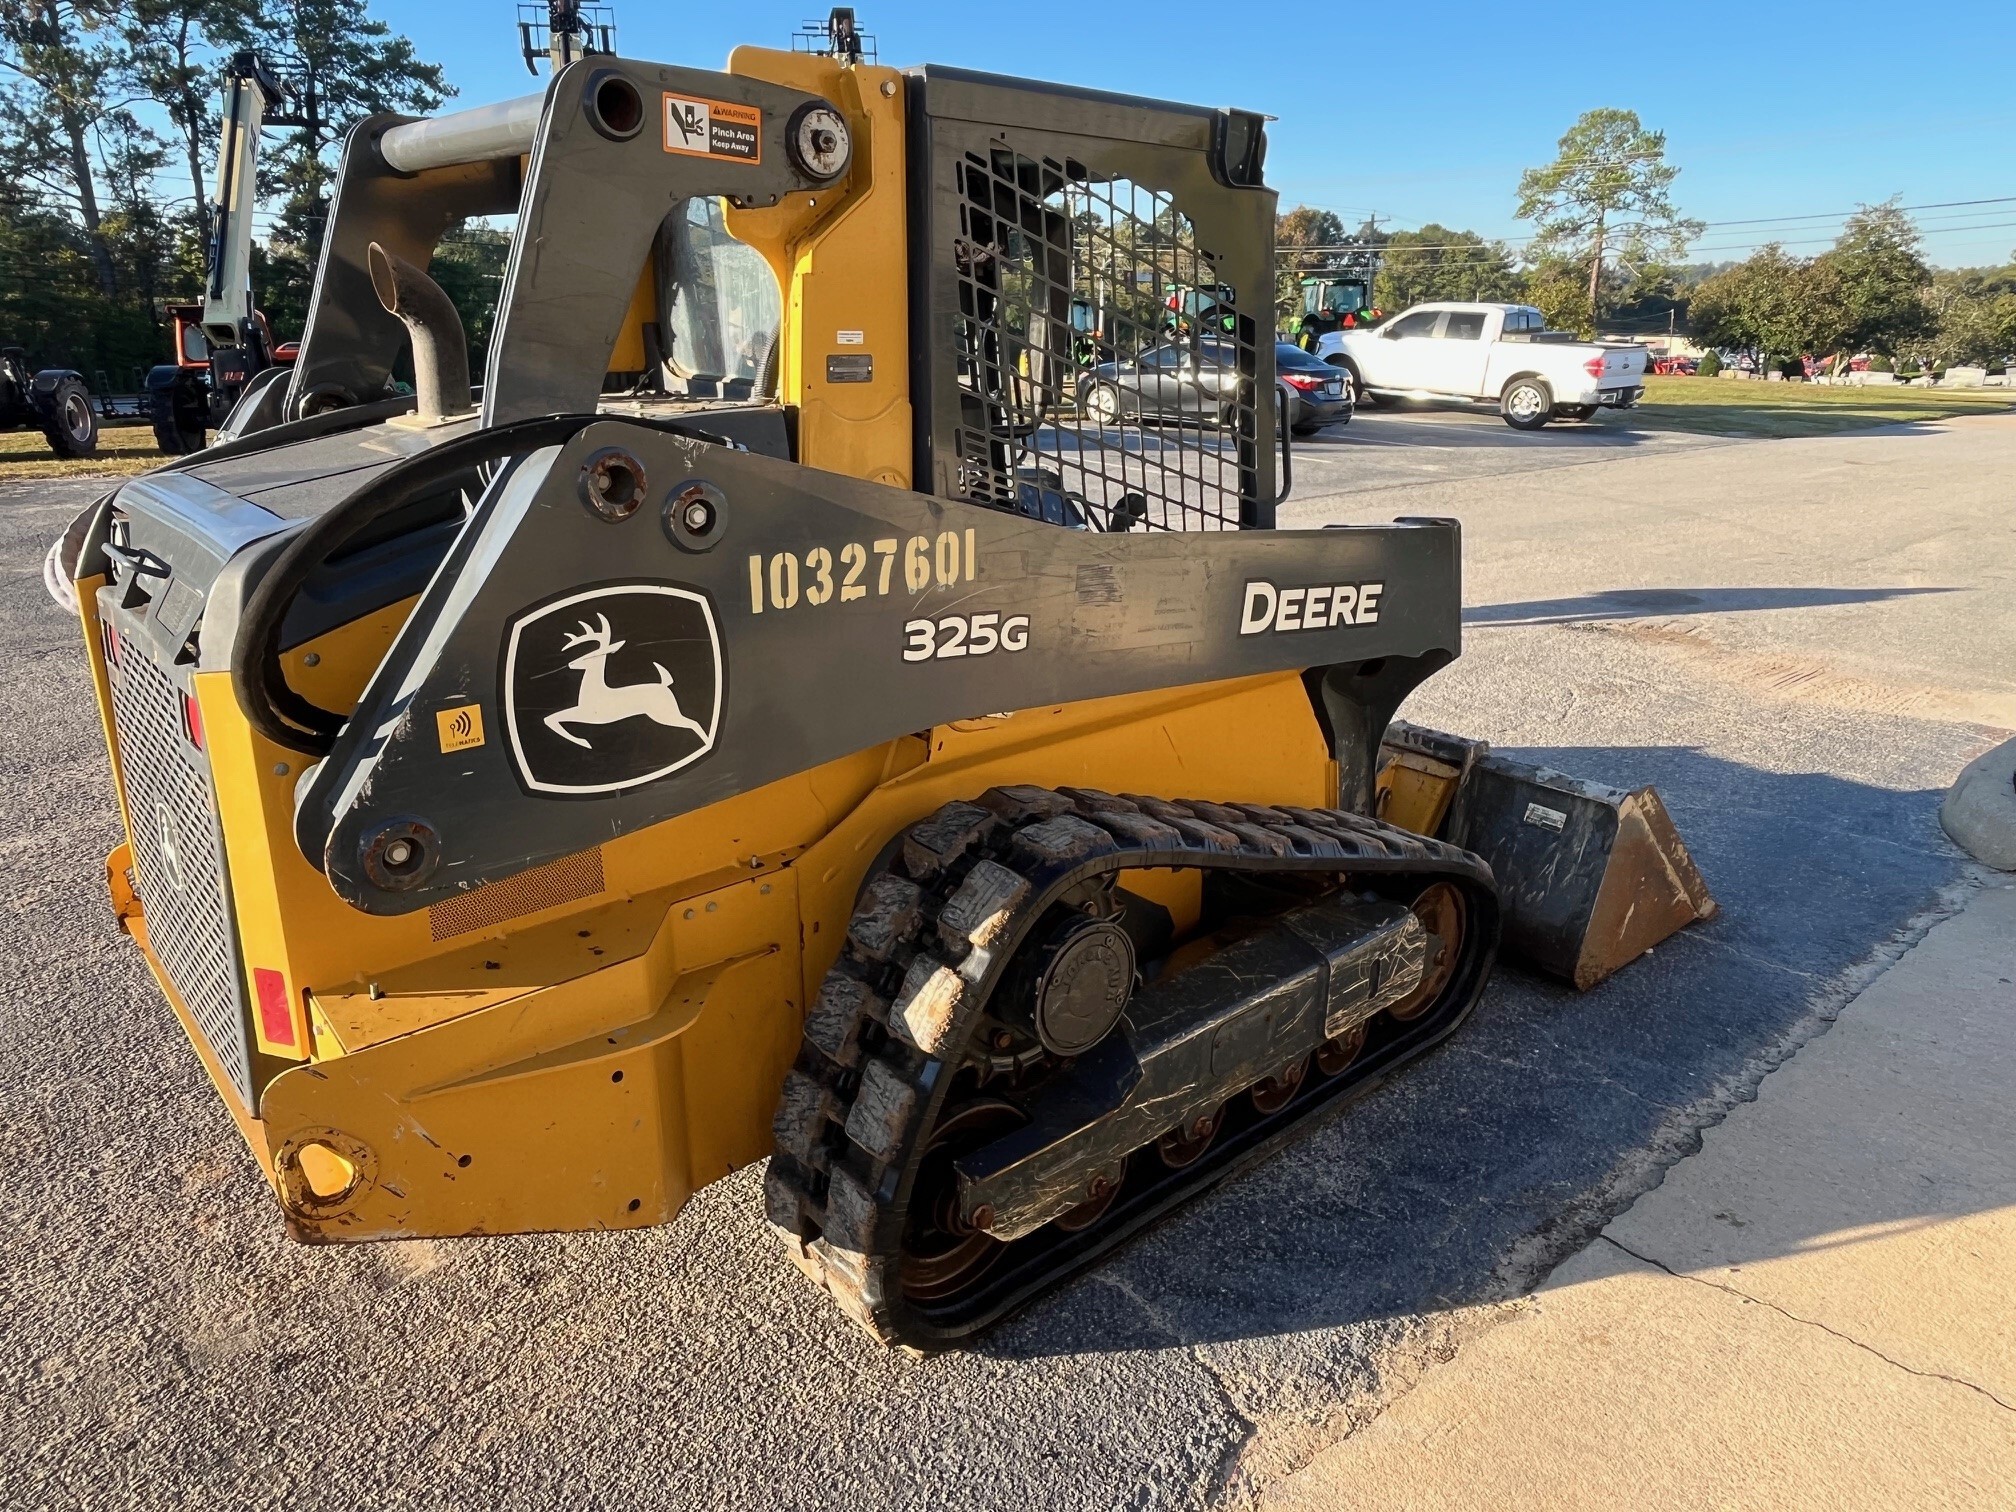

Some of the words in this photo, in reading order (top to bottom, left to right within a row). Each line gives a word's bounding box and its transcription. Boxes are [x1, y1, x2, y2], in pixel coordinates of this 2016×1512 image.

[721, 109, 756, 120] WARNING
[712, 126, 735, 138] Pinch
[736, 131, 755, 142] Area
[712, 139, 730, 150] Keep
[731, 142, 749, 153] Away
[749, 528, 975, 614] 10327601
[1240, 581, 1383, 634] DEERE
[903, 613, 1029, 662] 325G
